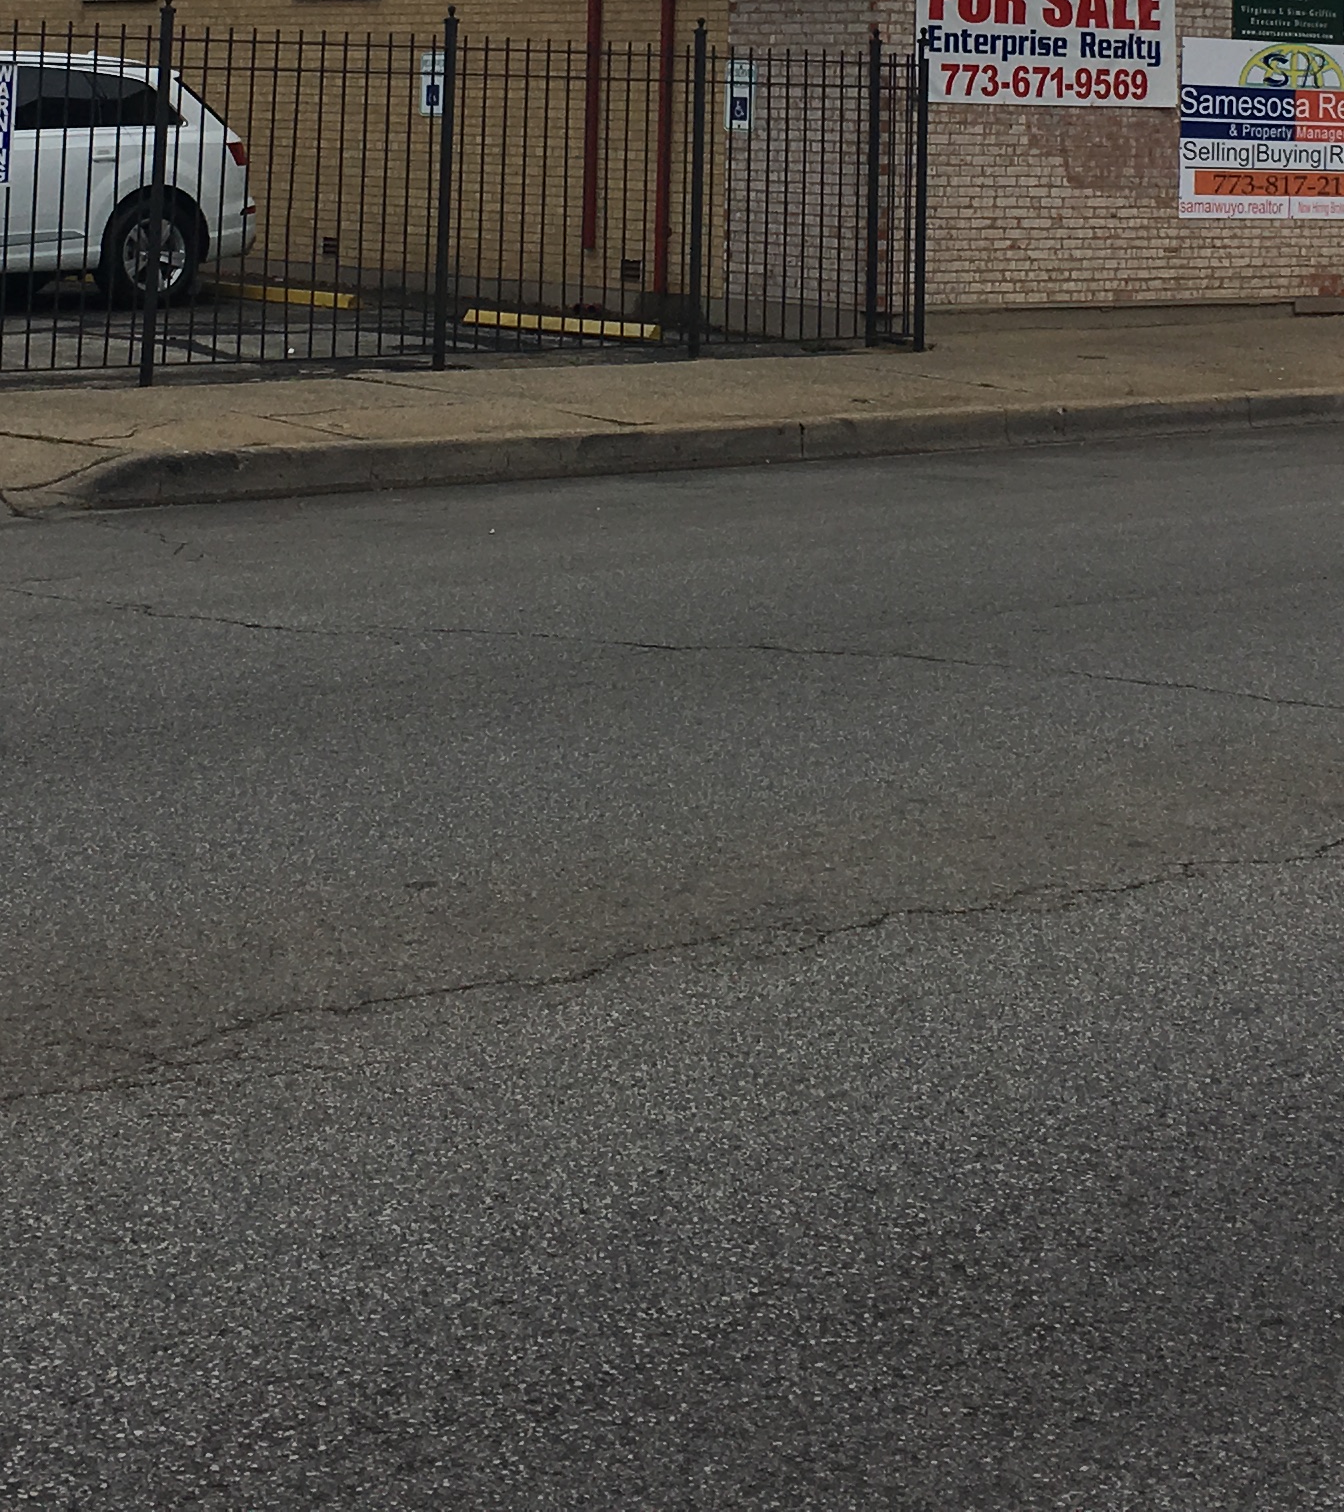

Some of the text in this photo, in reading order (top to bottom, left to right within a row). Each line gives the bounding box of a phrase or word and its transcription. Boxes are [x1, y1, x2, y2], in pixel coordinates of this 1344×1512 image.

[927, 25, 1161, 67] Enterprise Realty
[940, 63, 1148, 100] 773-671-9569
[1180, 87, 1310, 118] Samesosa
[1229, 124, 1238, 136] &
[1242, 124, 1293, 141] Property
[1182, 141, 1251, 166] Selling
[1256, 143, 1322, 168] Buying
